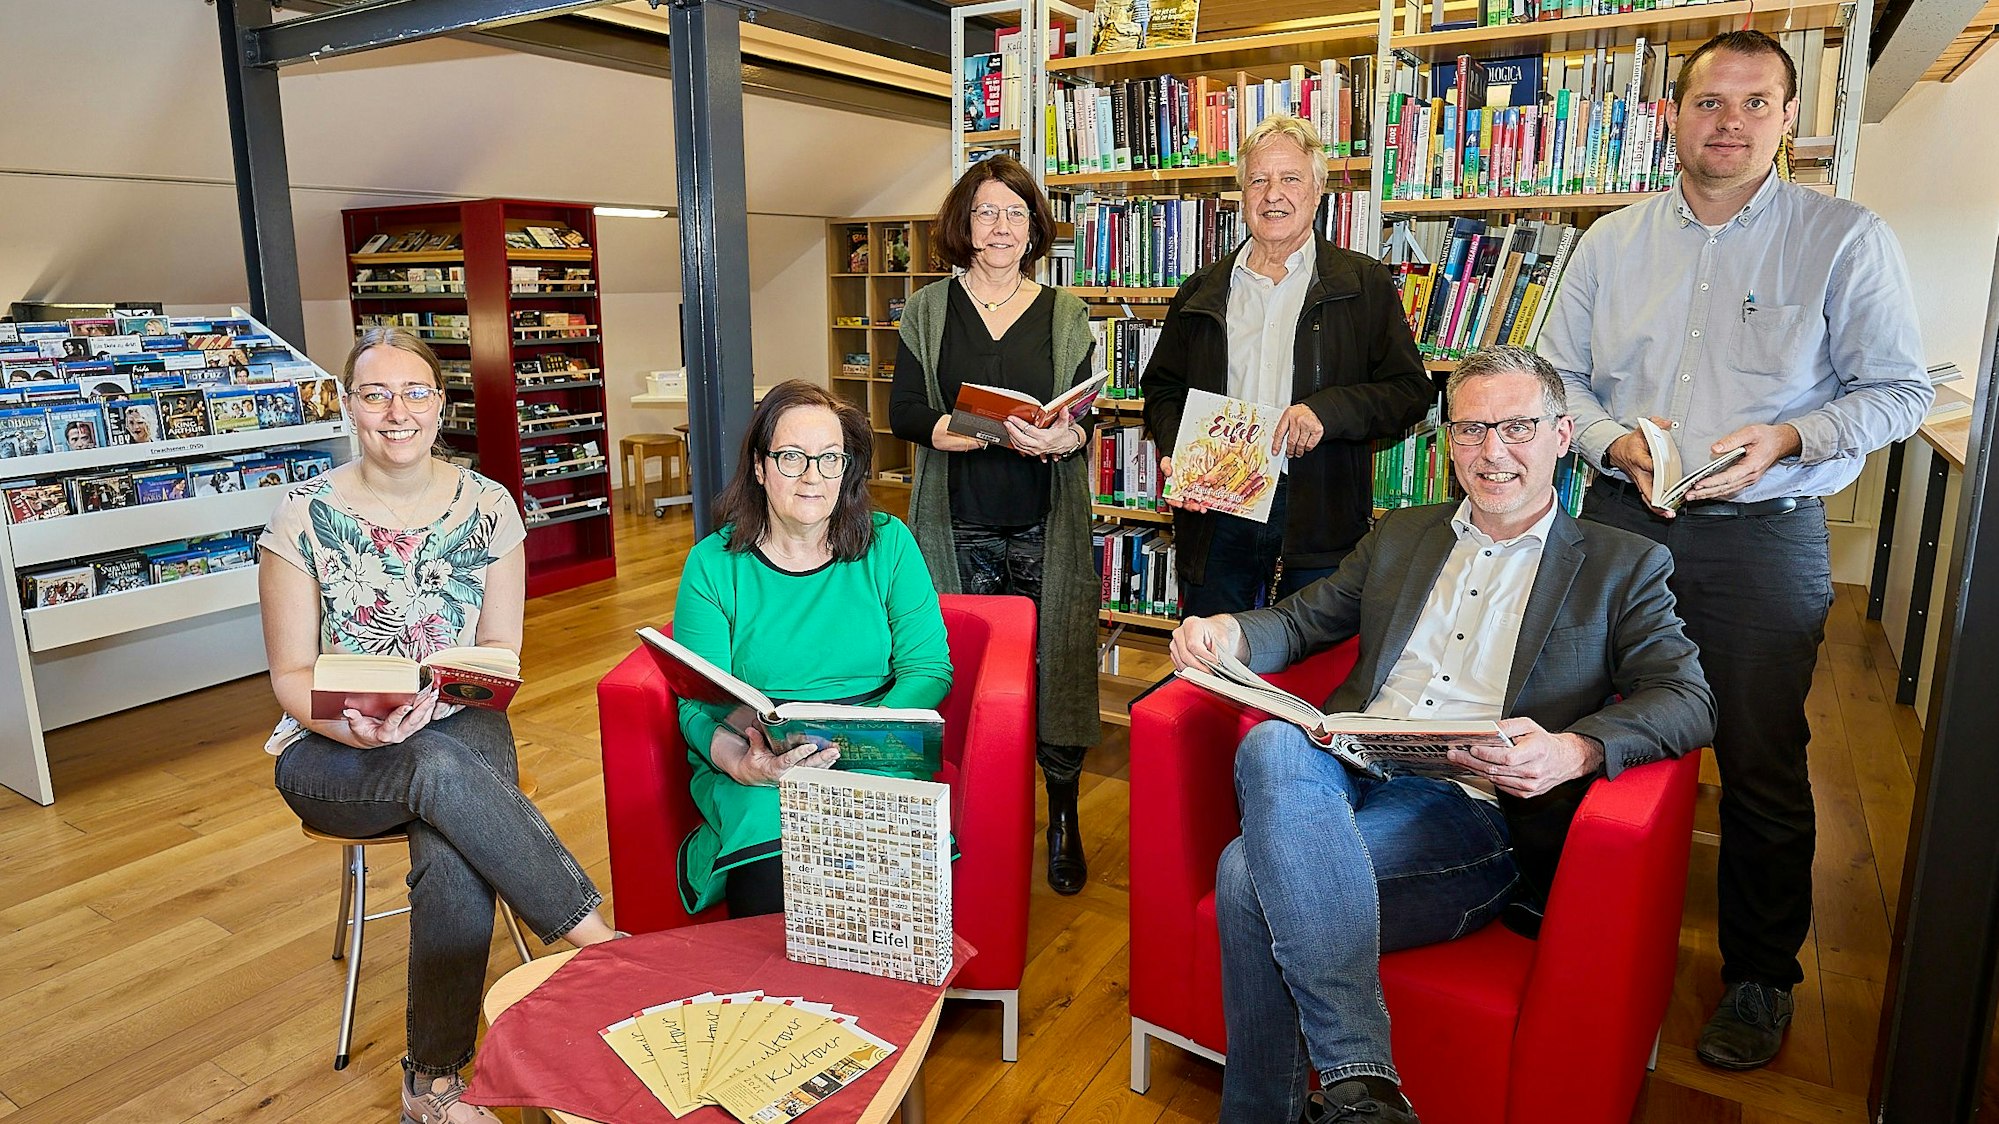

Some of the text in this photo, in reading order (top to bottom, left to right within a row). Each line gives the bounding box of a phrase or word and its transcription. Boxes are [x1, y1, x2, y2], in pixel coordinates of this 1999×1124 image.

[1633, 42, 1643, 85] SCHOTTLAND
[1388, 126, 1396, 145] 2017
[1419, 119, 1428, 139] Wien
[1387, 149, 1395, 170] Europa
[1633, 140, 1644, 163] Ibiza
[1438, 227, 1455, 275] SKANDINAVIEN
[1467, 240, 1479, 263] ISLAND
[132, 364, 150, 373] Frida
[168, 426, 206, 436] ARTHUR
[174, 421, 198, 429] KING
[1208, 415, 1260, 444] Eifel
[112, 434, 131, 446] JOY
[150, 445, 186, 455] Erwachsenen
[1102, 574, 1111, 603] AMON
[1347, 743, 1449, 755] Chronik
[898, 815, 909, 826] in
[798, 864, 815, 874] der
[872, 930, 909, 949] Eifel
[765, 1036, 840, 1085] Kultour
